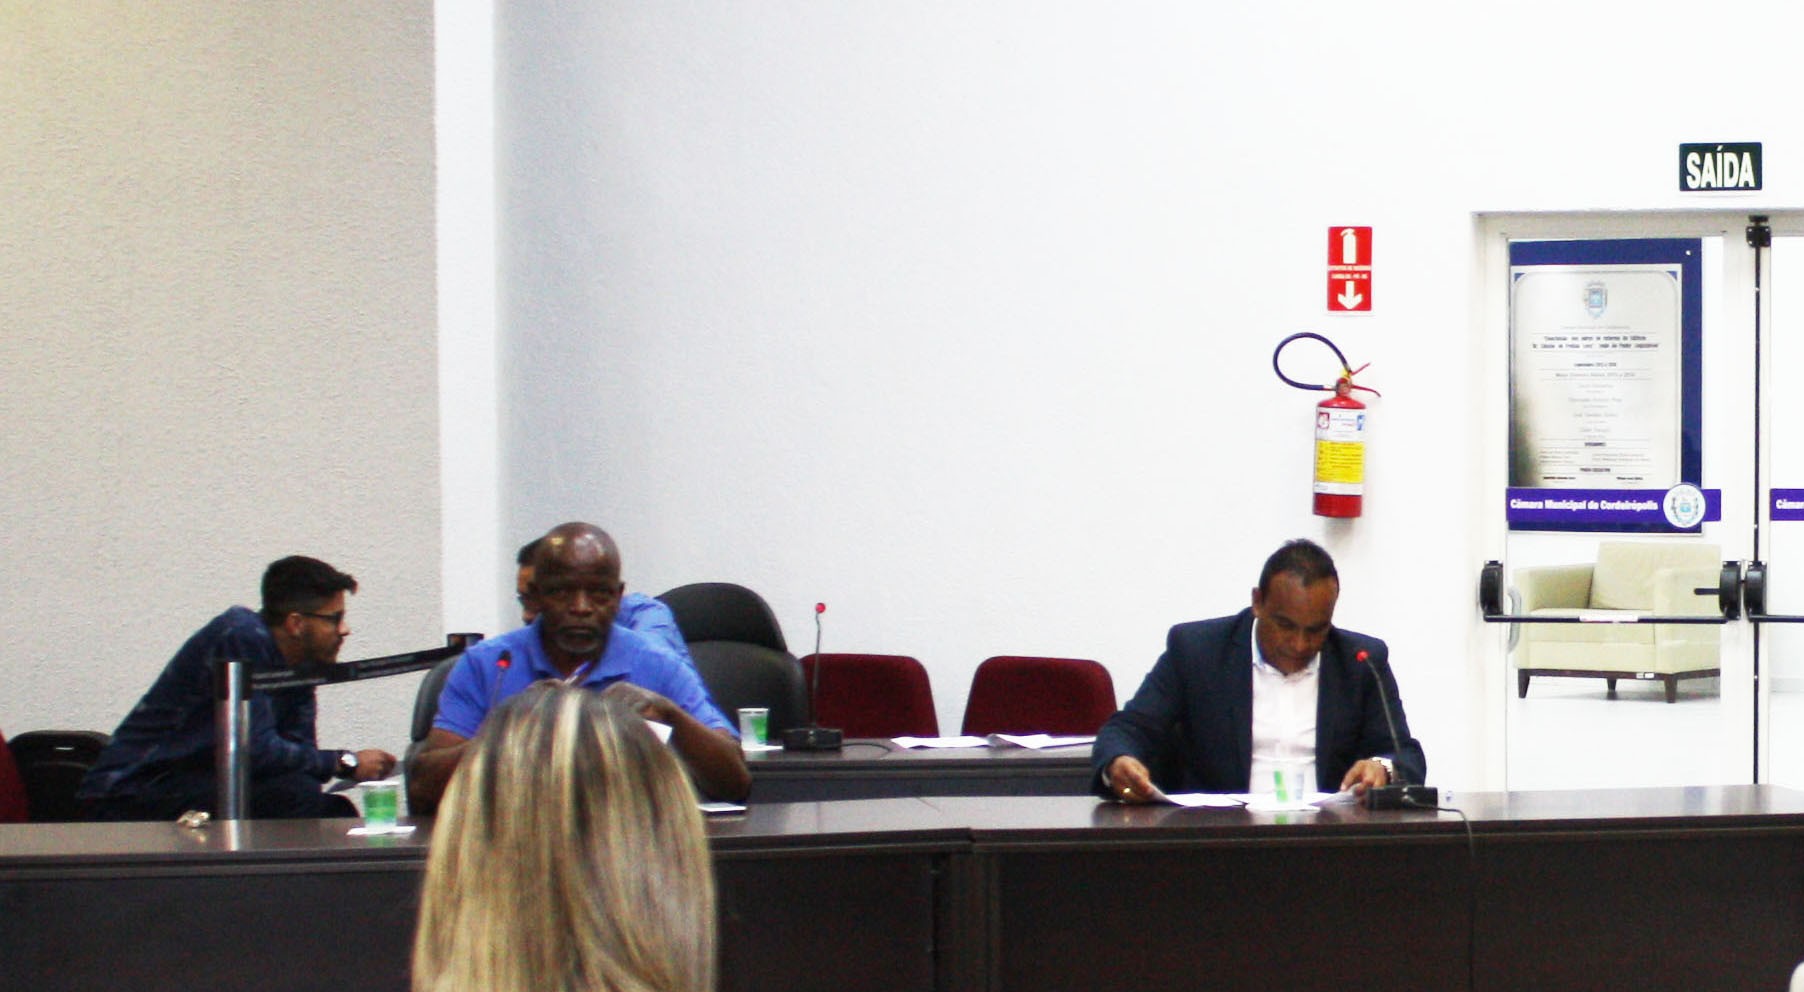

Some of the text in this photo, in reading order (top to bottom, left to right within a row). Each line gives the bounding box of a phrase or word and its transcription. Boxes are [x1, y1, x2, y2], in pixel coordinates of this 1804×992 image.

[1686, 145, 1755, 189] SAÍDA
[1510, 498, 1543, 510] Câmara
[1544, 499, 1587, 511] Municipal
